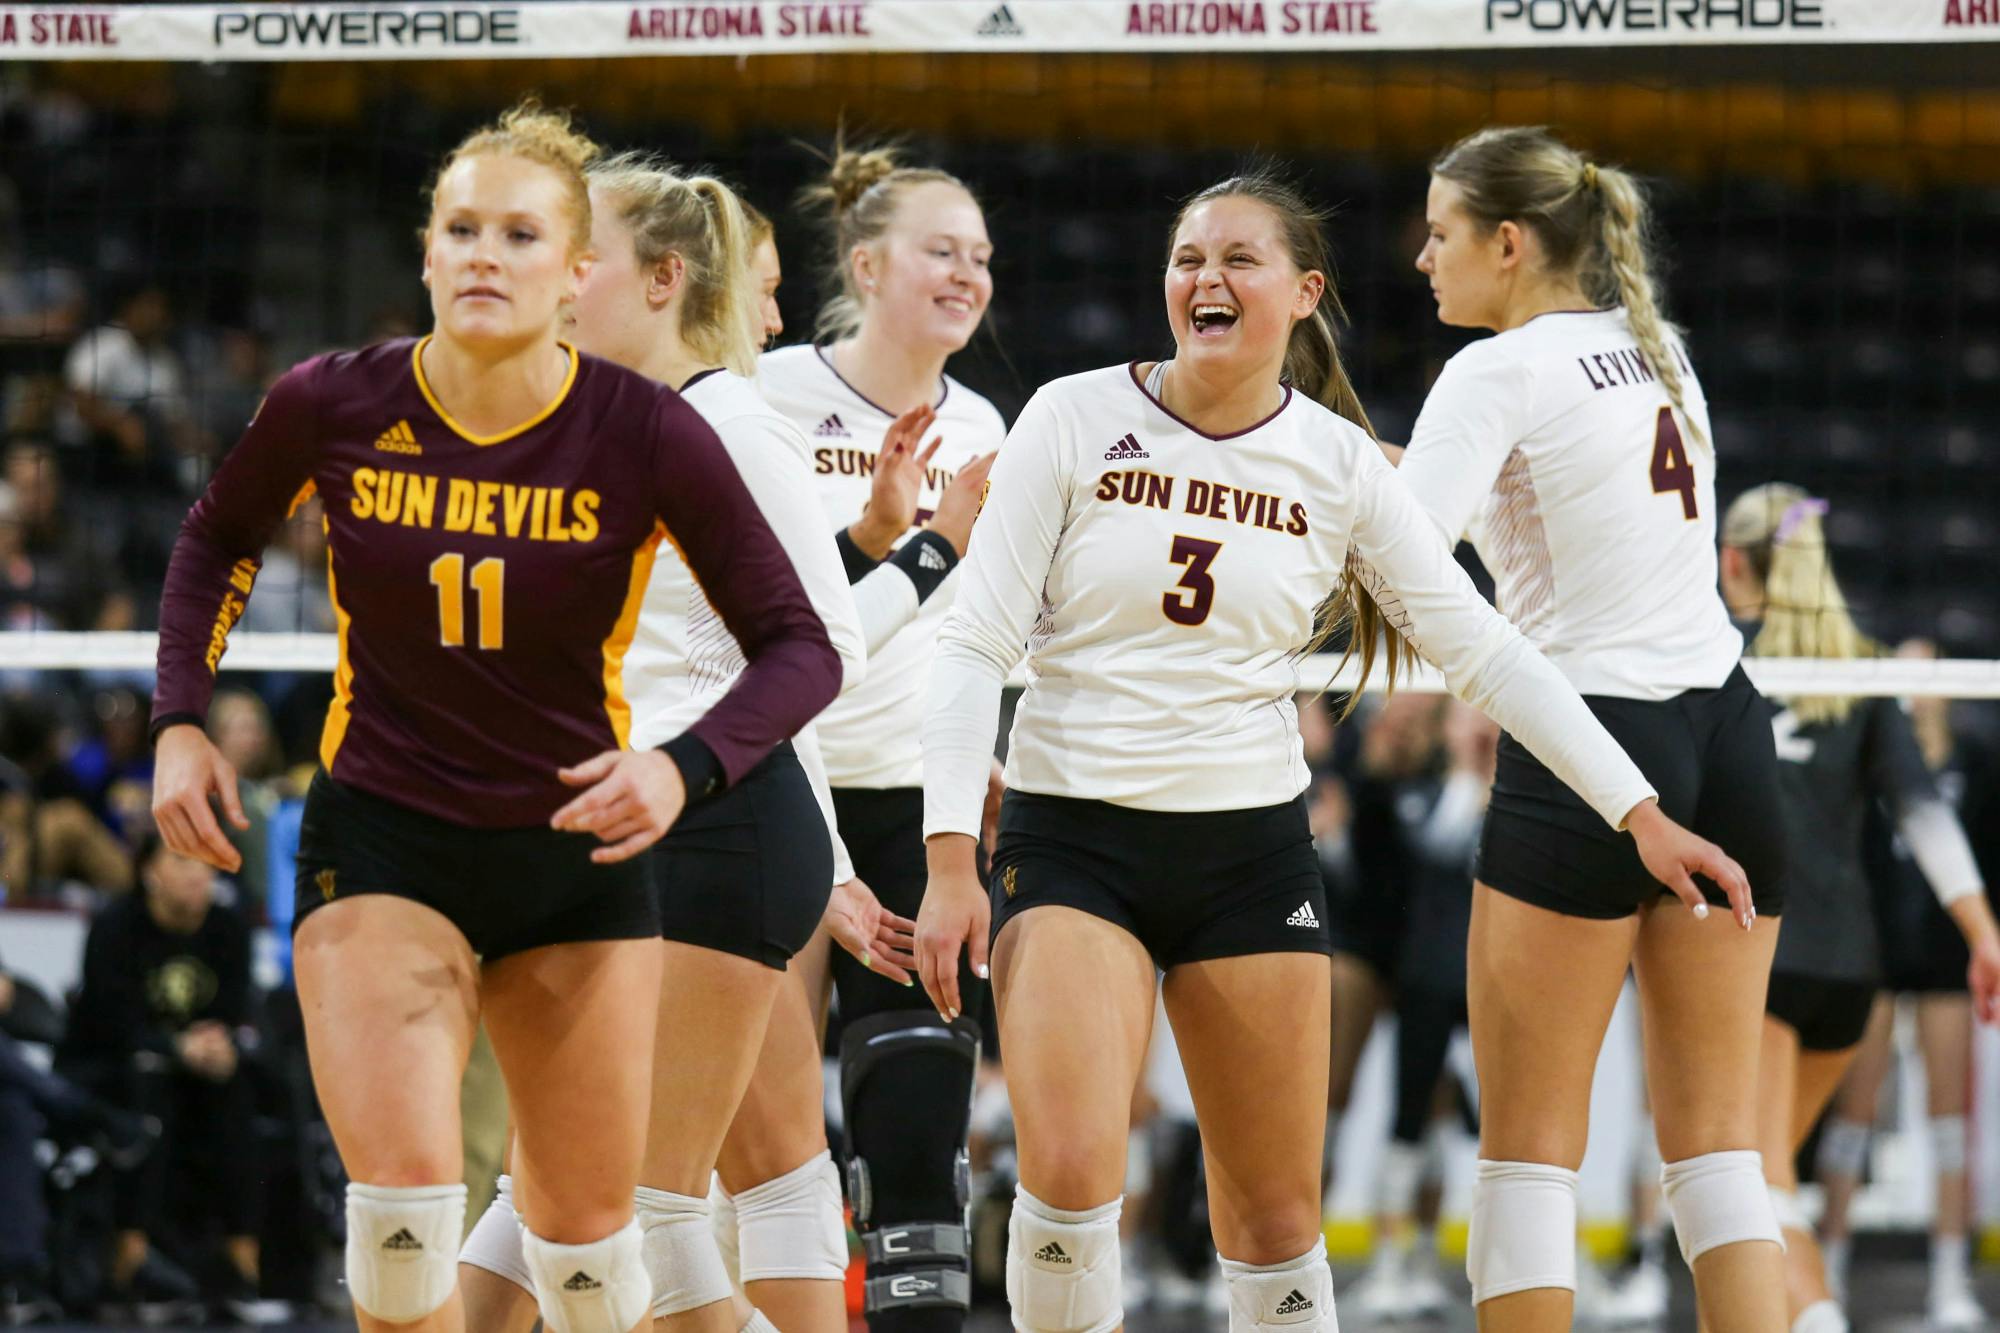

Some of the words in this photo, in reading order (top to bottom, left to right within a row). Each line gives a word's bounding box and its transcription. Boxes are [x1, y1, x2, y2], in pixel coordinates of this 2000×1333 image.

[31, 13, 117, 45] STATE
[214, 11, 519, 45] POWERADE
[628, 6, 763, 39] ARIZONA
[777, 4, 871, 37] STATE
[1127, 2, 1266, 34] ARIZONA
[1282, 1, 1377, 34] STATE
[1486, 0, 1823, 31] POWERADE
[374, 439, 422, 456] adidas
[814, 448, 876, 477] SUN
[1104, 449, 1150, 461] adidas
[1649, 405, 1698, 521] 4
[351, 467, 438, 528] SUN
[444, 478, 601, 542] DEVILS
[1095, 470, 1175, 510] SUN
[1184, 478, 1309, 537] DEVILS
[1161, 534, 1225, 626] 3
[429, 552, 505, 650] 11
[1286, 916, 1320, 928] adidas
[1034, 1252, 1072, 1264] adidas
[1276, 1300, 1313, 1315] adidas
